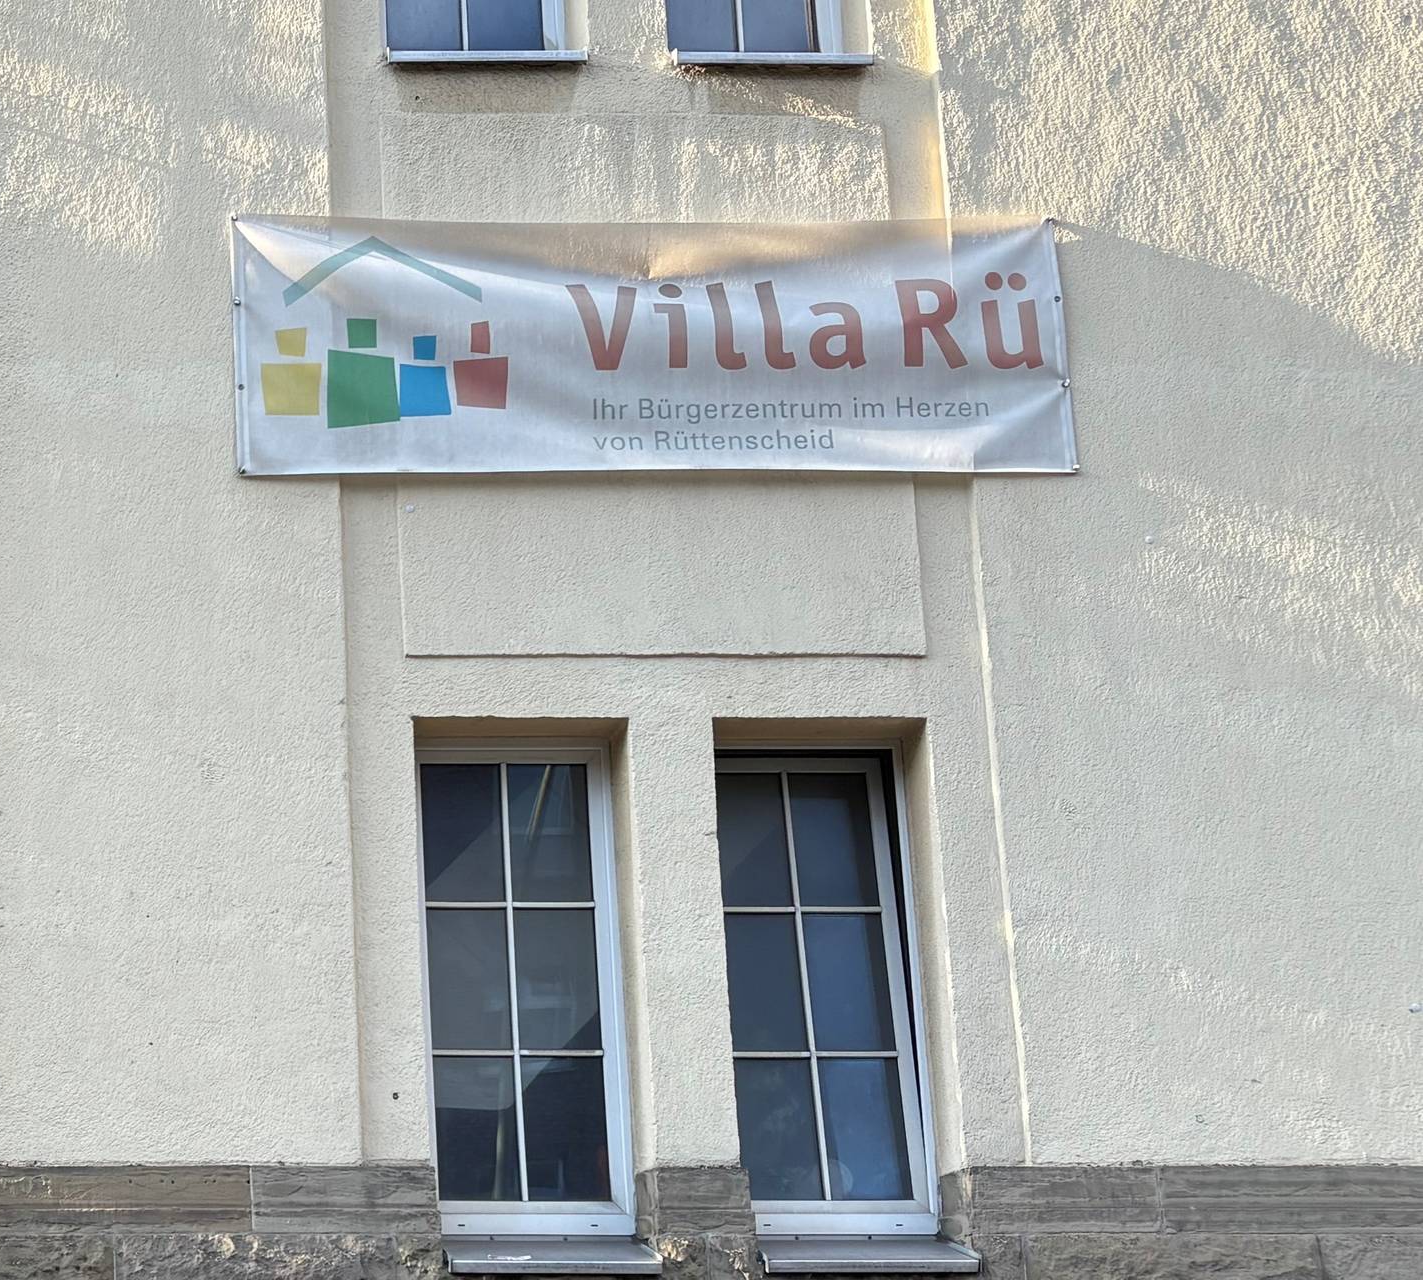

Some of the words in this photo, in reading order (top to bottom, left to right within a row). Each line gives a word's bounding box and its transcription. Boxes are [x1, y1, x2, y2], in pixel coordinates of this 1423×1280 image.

[564, 279, 867, 371] Villa
[894, 271, 1045, 370] Rü
[592, 398, 628, 420] Ihr
[639, 398, 843, 425] Bürgerzentrum
[853, 397, 885, 418] im
[896, 397, 990, 418] Herzen
[592, 434, 644, 451] von
[654, 429, 835, 450] Rüttenscheid
